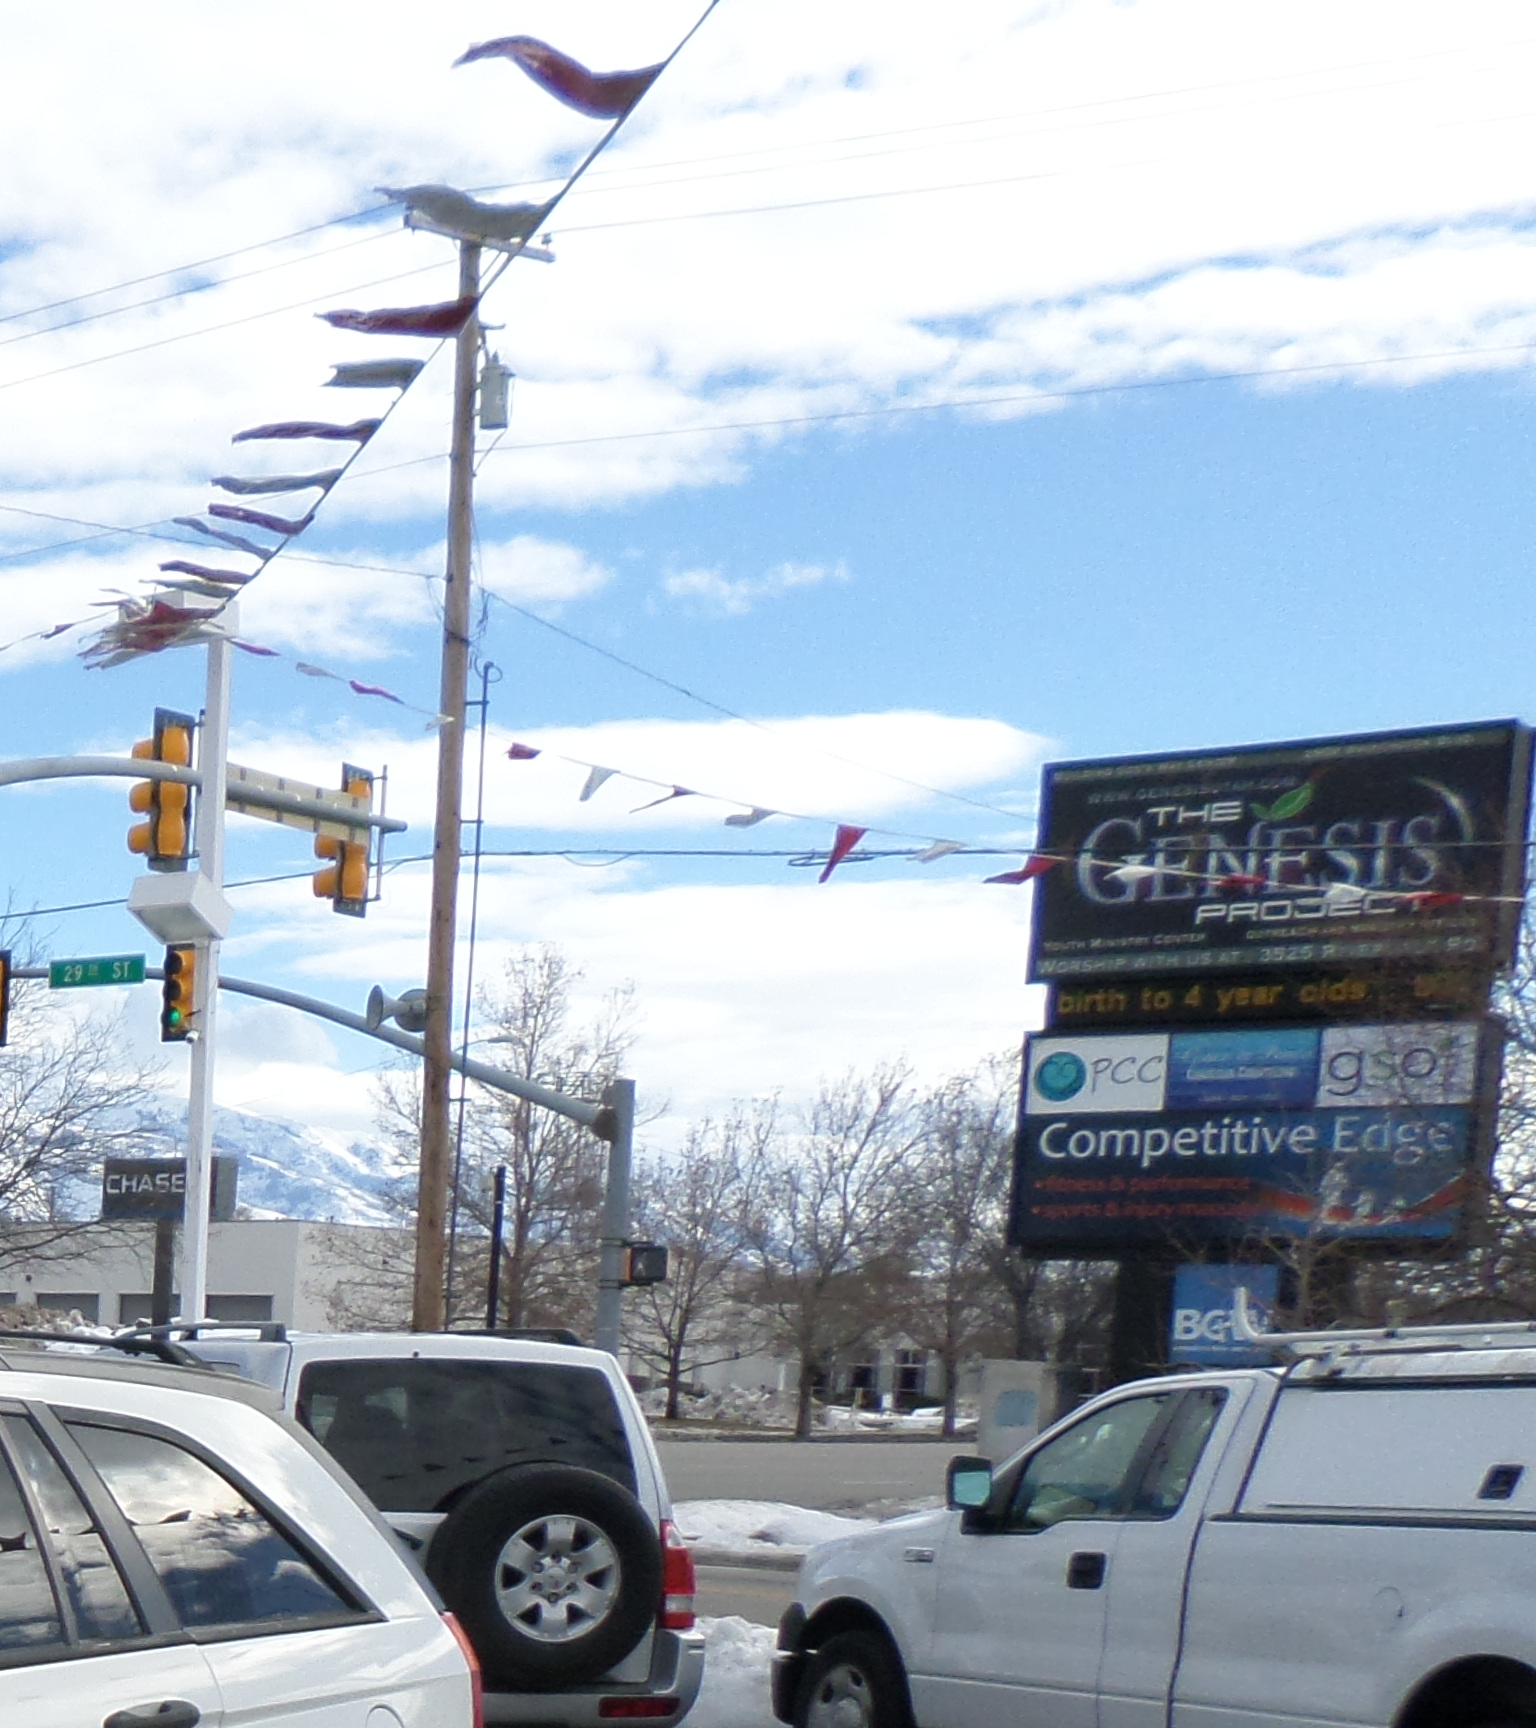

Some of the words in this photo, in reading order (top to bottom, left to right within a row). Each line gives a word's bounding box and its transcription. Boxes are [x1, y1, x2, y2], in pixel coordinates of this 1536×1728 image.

[1145, 800, 1244, 827] THE
[1075, 813, 1444, 905] GENESIS
[112, 960, 131, 979] ST
[1057, 988, 1126, 1014] birth
[1140, 986, 1173, 1012] to
[1183, 984, 1203, 1008] 4
[1216, 983, 1284, 1014] year
[1091, 1055, 1165, 1096] PCC
[1038, 1117, 1319, 1168] Competitive
[1333, 1111, 1454, 1165] Edge
[105, 1172, 186, 1196] CHASE
